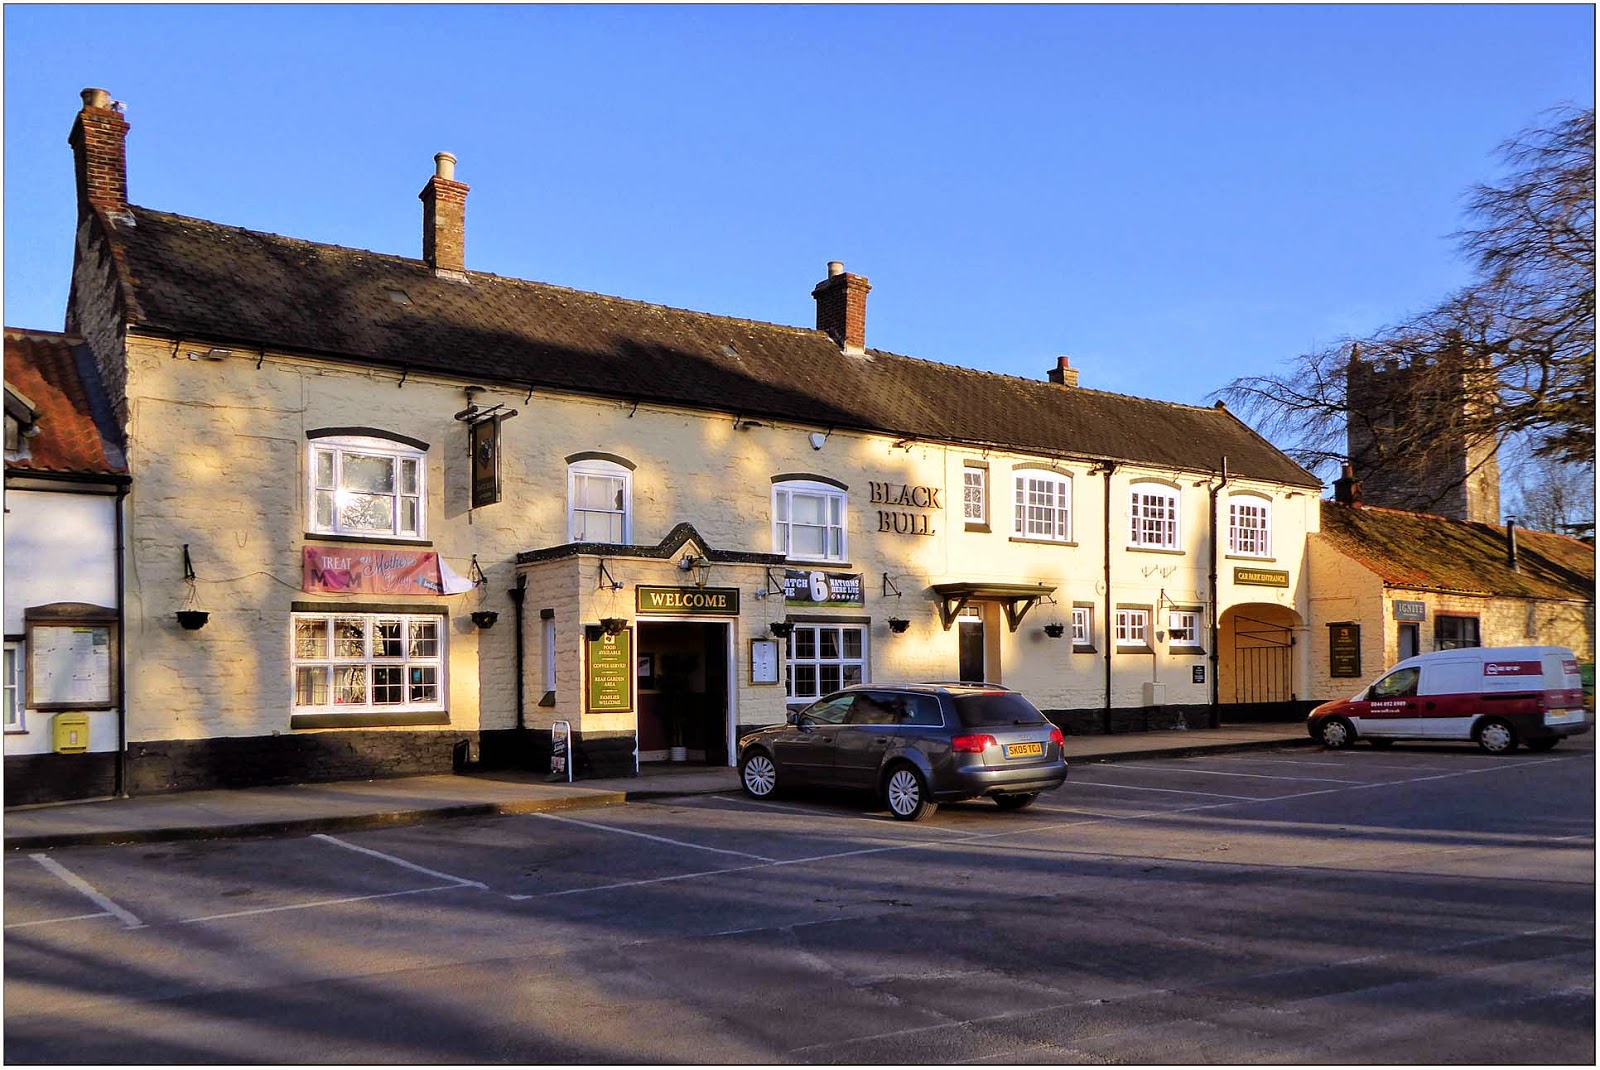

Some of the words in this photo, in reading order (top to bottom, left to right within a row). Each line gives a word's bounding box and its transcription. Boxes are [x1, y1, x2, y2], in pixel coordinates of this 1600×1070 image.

[869, 481, 943, 509] BLACK
[877, 510, 936, 536] BULL
[321, 556, 352, 569] TREAT
[829, 578, 860, 587] NATIONS
[1238, 572, 1248, 580] CAR
[1261, 574, 1286, 582] ENTRANCE
[809, 571, 828, 602] 6
[650, 592, 727, 608] WELCOME
[1398, 603, 1424, 614] IGNITE
